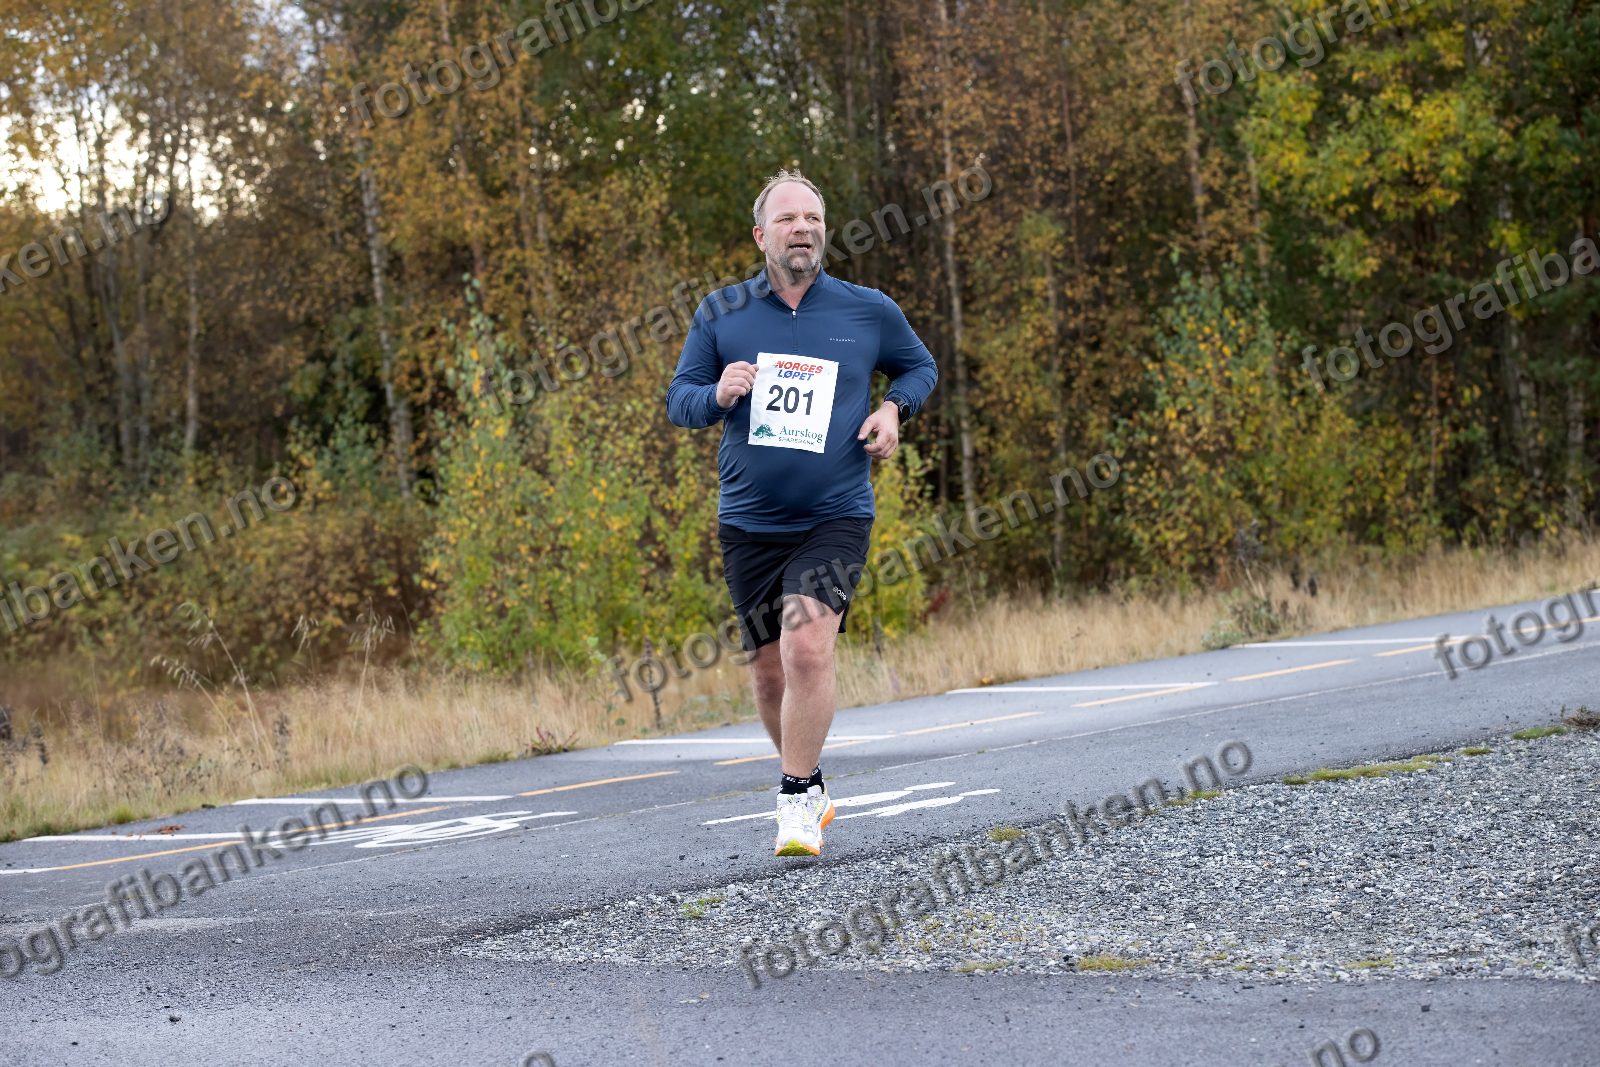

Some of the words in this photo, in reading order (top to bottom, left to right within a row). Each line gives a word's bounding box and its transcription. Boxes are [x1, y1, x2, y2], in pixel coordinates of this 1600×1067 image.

[774, 360, 824, 374] NORGES
[777, 369, 815, 381] LØPET
[765, 384, 814, 415] 201
[779, 425, 824, 443] Aurskog
